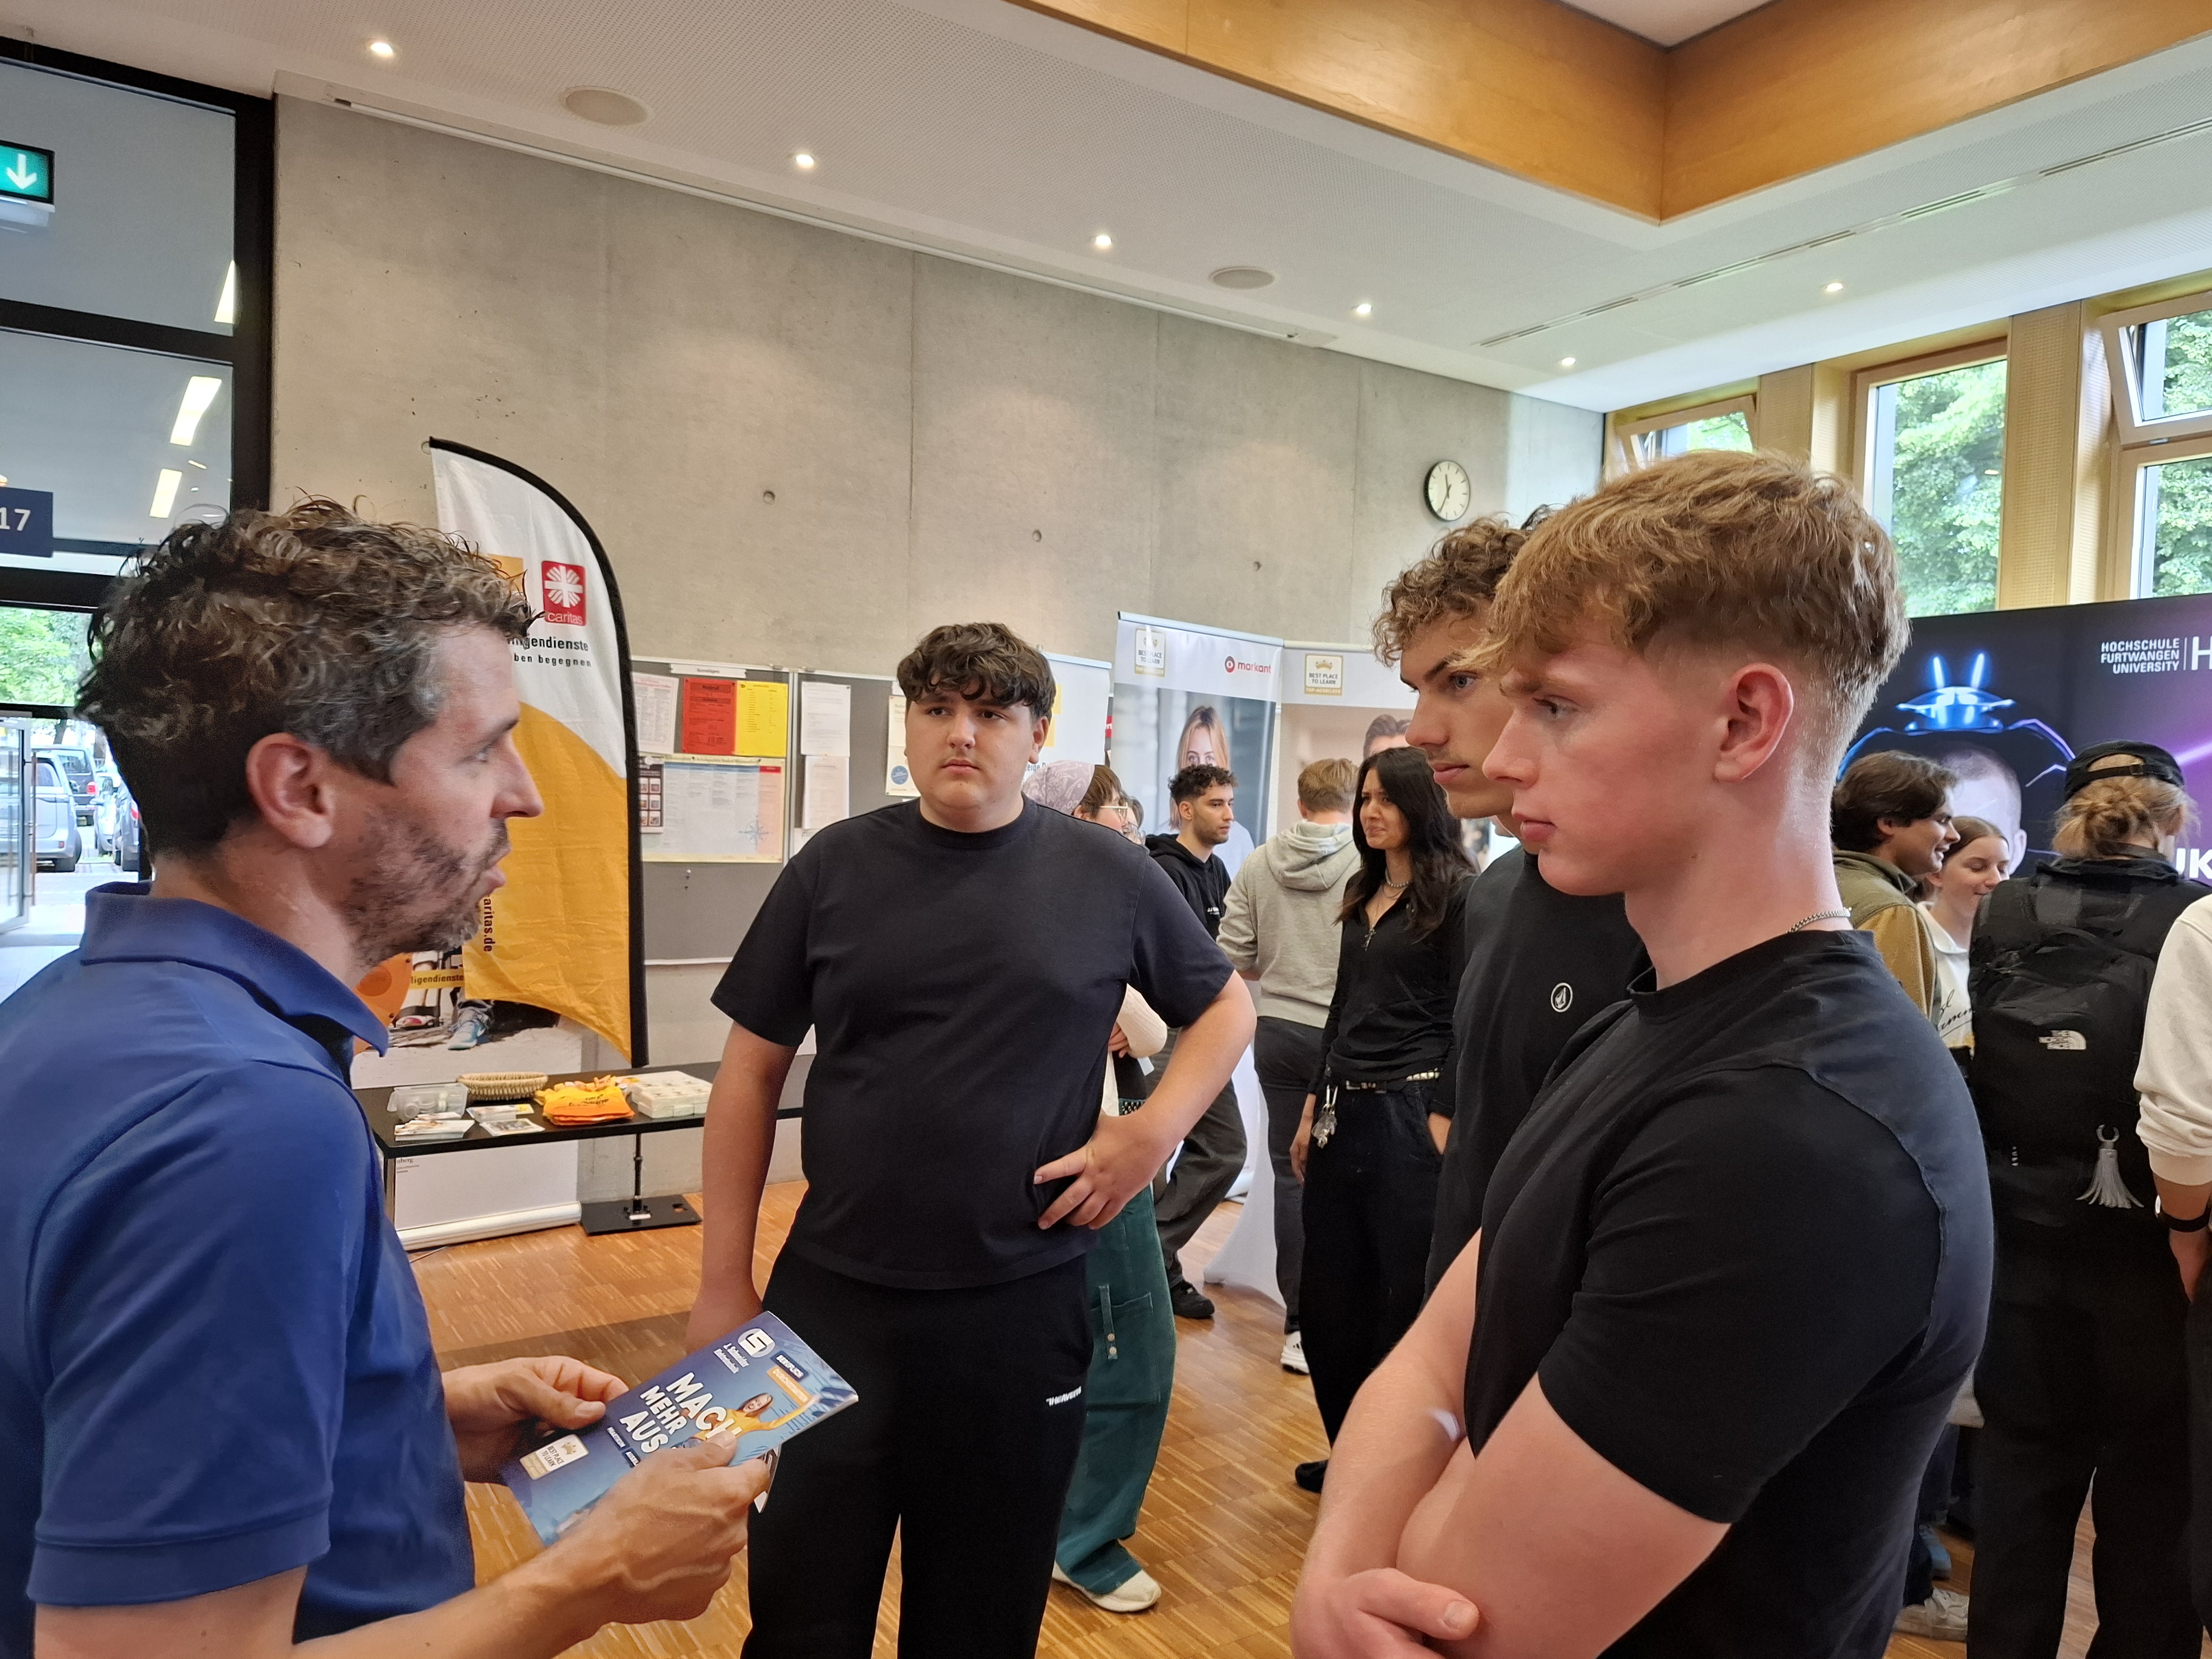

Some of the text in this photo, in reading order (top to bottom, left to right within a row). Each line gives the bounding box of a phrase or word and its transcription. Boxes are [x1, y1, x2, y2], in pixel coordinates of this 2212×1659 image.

[547, 612, 584, 625] caritas
[2101, 638, 2180, 652] HOCHSCHULE
[514, 652, 591, 667] ben begegnen
[2101, 650, 2179, 664] FURTWANGEN
[1238, 661, 1271, 673] markant
[2113, 660, 2179, 674] UNIVERSITY
[483, 897, 496, 953] aritas.de
[411, 974, 464, 986] ligendienste
[640, 1385, 687, 1435] MEHR
[665, 1372, 743, 1439] MACH
[619, 1411, 669, 1454] AUS
[544, 1456, 556, 1467] LEARN
[547, 1445, 564, 1465] BEST PLACE
